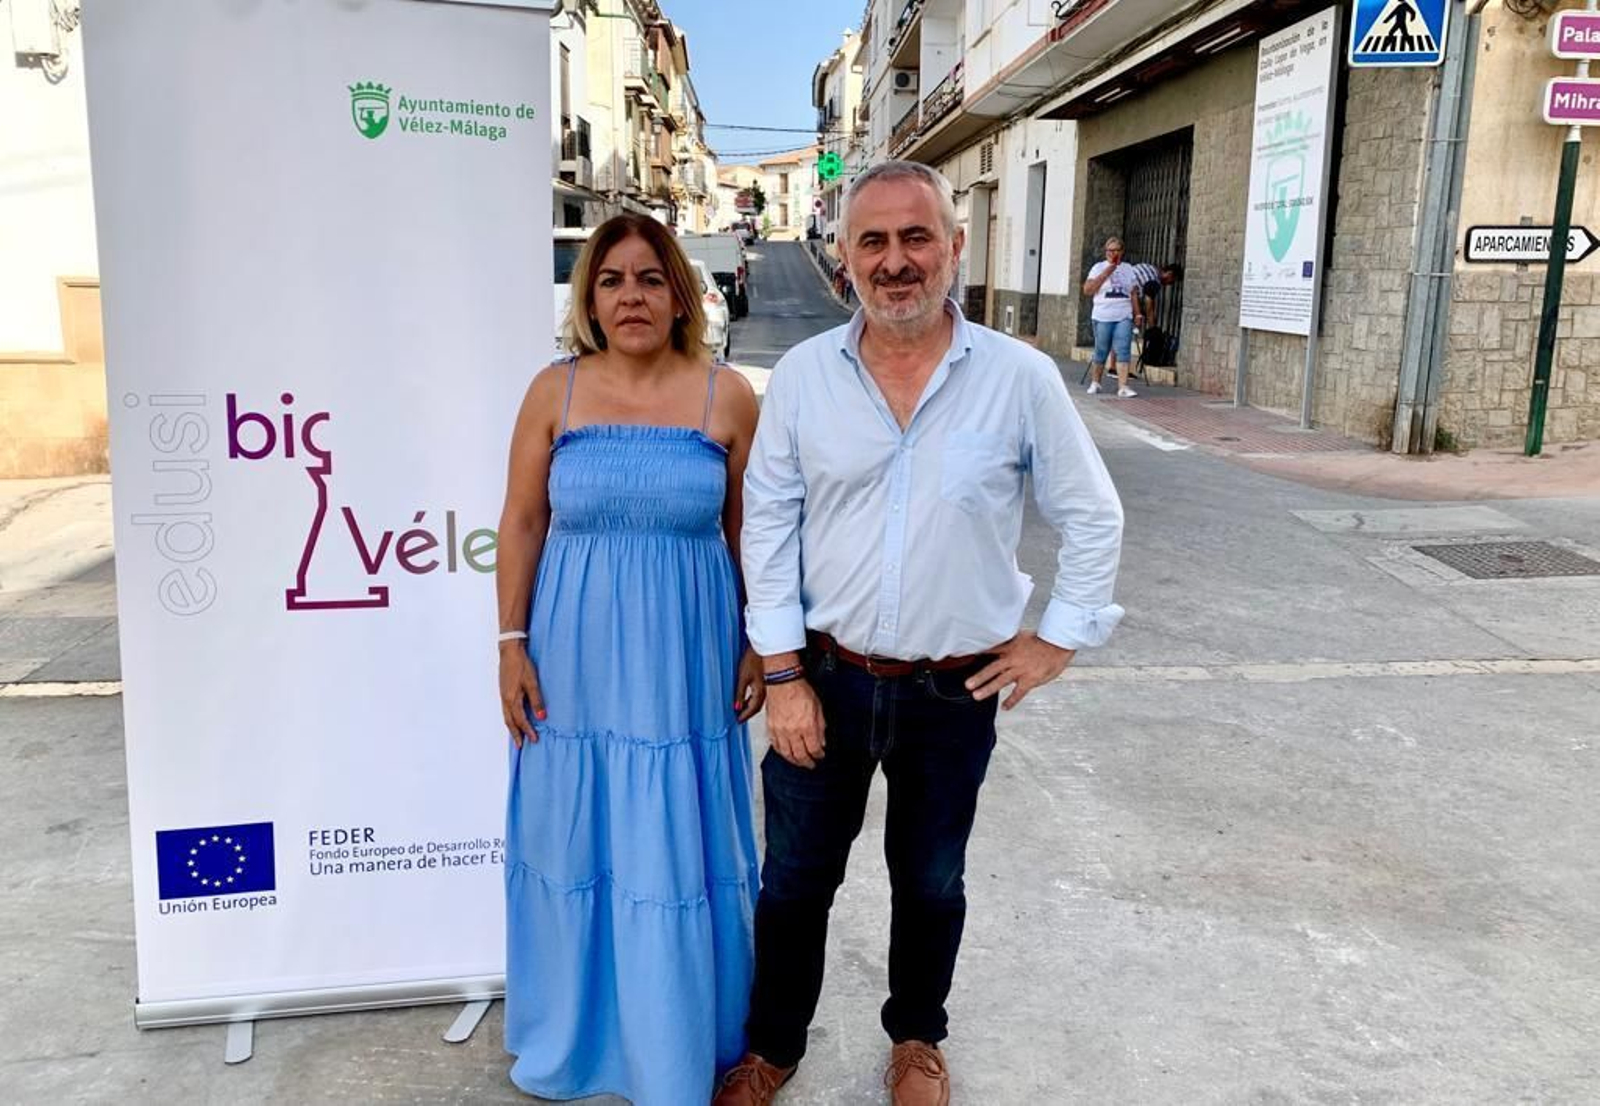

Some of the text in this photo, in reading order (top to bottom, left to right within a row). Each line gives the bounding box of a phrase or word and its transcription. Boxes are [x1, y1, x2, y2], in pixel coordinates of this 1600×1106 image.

[1563, 26, 1600, 43] Pala
[398, 95, 535, 120] Ayuntamiento de
[399, 116, 507, 141] Vélez-Málaga
[1474, 235, 1576, 252] APARCAMIENS
[124, 392, 218, 617] edusi
[309, 827, 375, 846] FEDER
[309, 848, 350, 860] Fondo
[352, 845, 405, 858] Europeo
[408, 843, 424, 855] de
[427, 838, 491, 853] Desarrollo
[310, 861, 344, 875] Una
[349, 858, 412, 873] manera
[416, 855, 437, 869] de
[441, 853, 487, 867] hacer
[159, 895, 278, 915] Unión Europea
